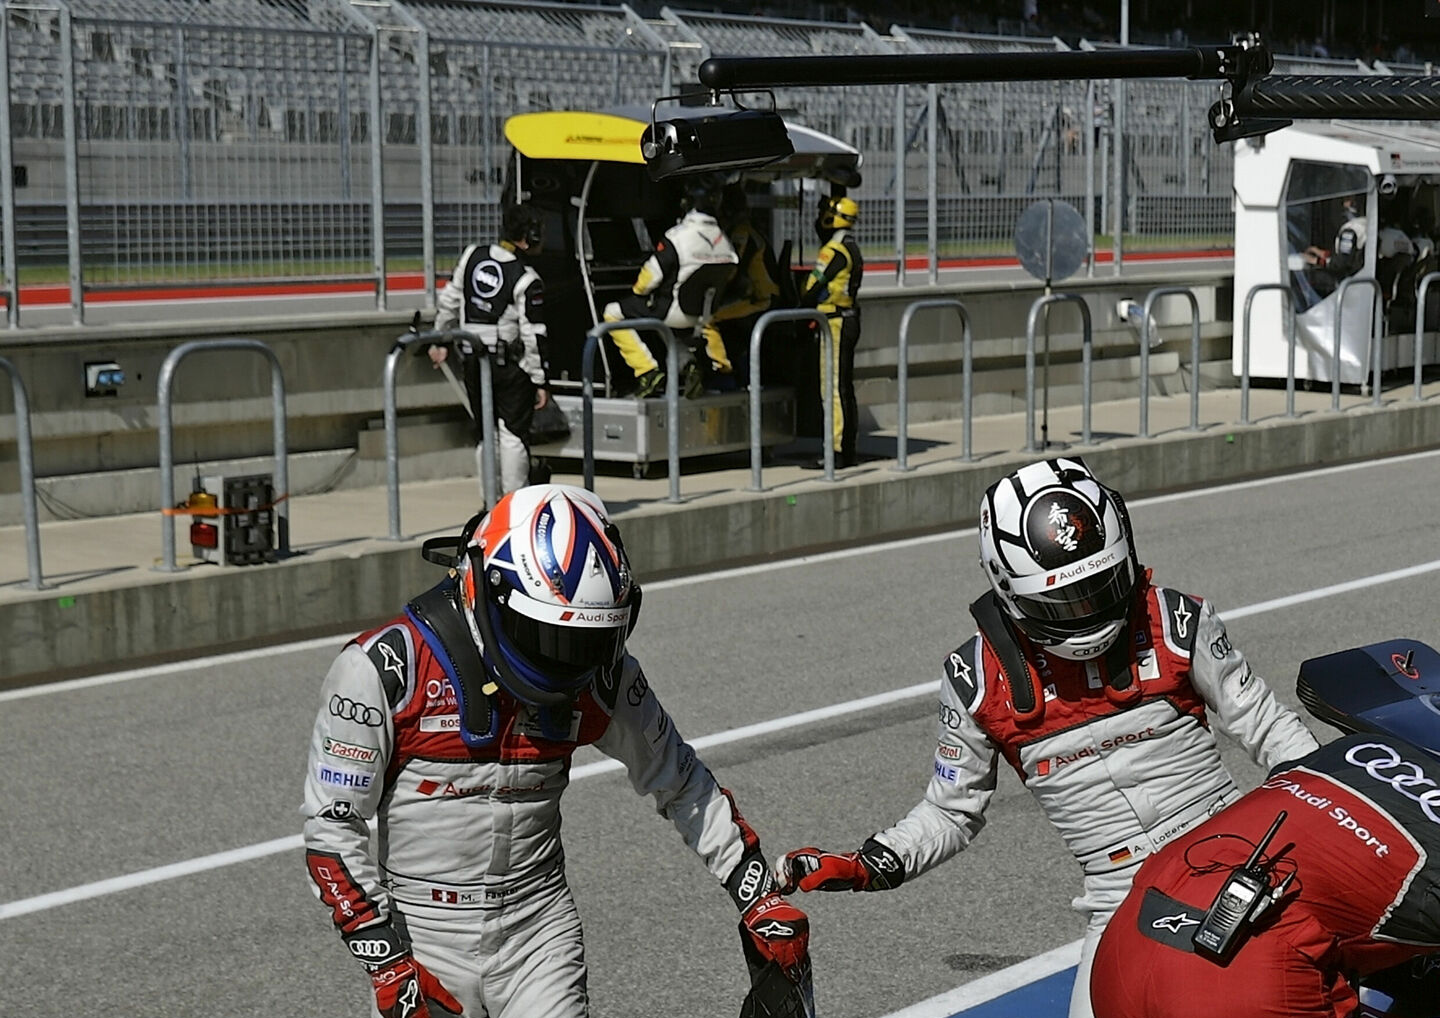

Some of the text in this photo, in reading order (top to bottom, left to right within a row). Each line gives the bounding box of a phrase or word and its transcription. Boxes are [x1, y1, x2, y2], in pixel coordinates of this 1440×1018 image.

[1059, 551, 1115, 581] Audi Sport
[576, 613, 604, 622] Audi
[440, 719, 460, 728] BOS
[331, 742, 375, 761] Castrol
[1055, 727, 1155, 768] Audi Sport
[321, 767, 371, 788] MAHLE
[442, 781, 545, 797] Audi Sport
[1281, 783, 1389, 858] Audi Sport
[1134, 845, 1146, 853] A.
[461, 894, 476, 902] M.
